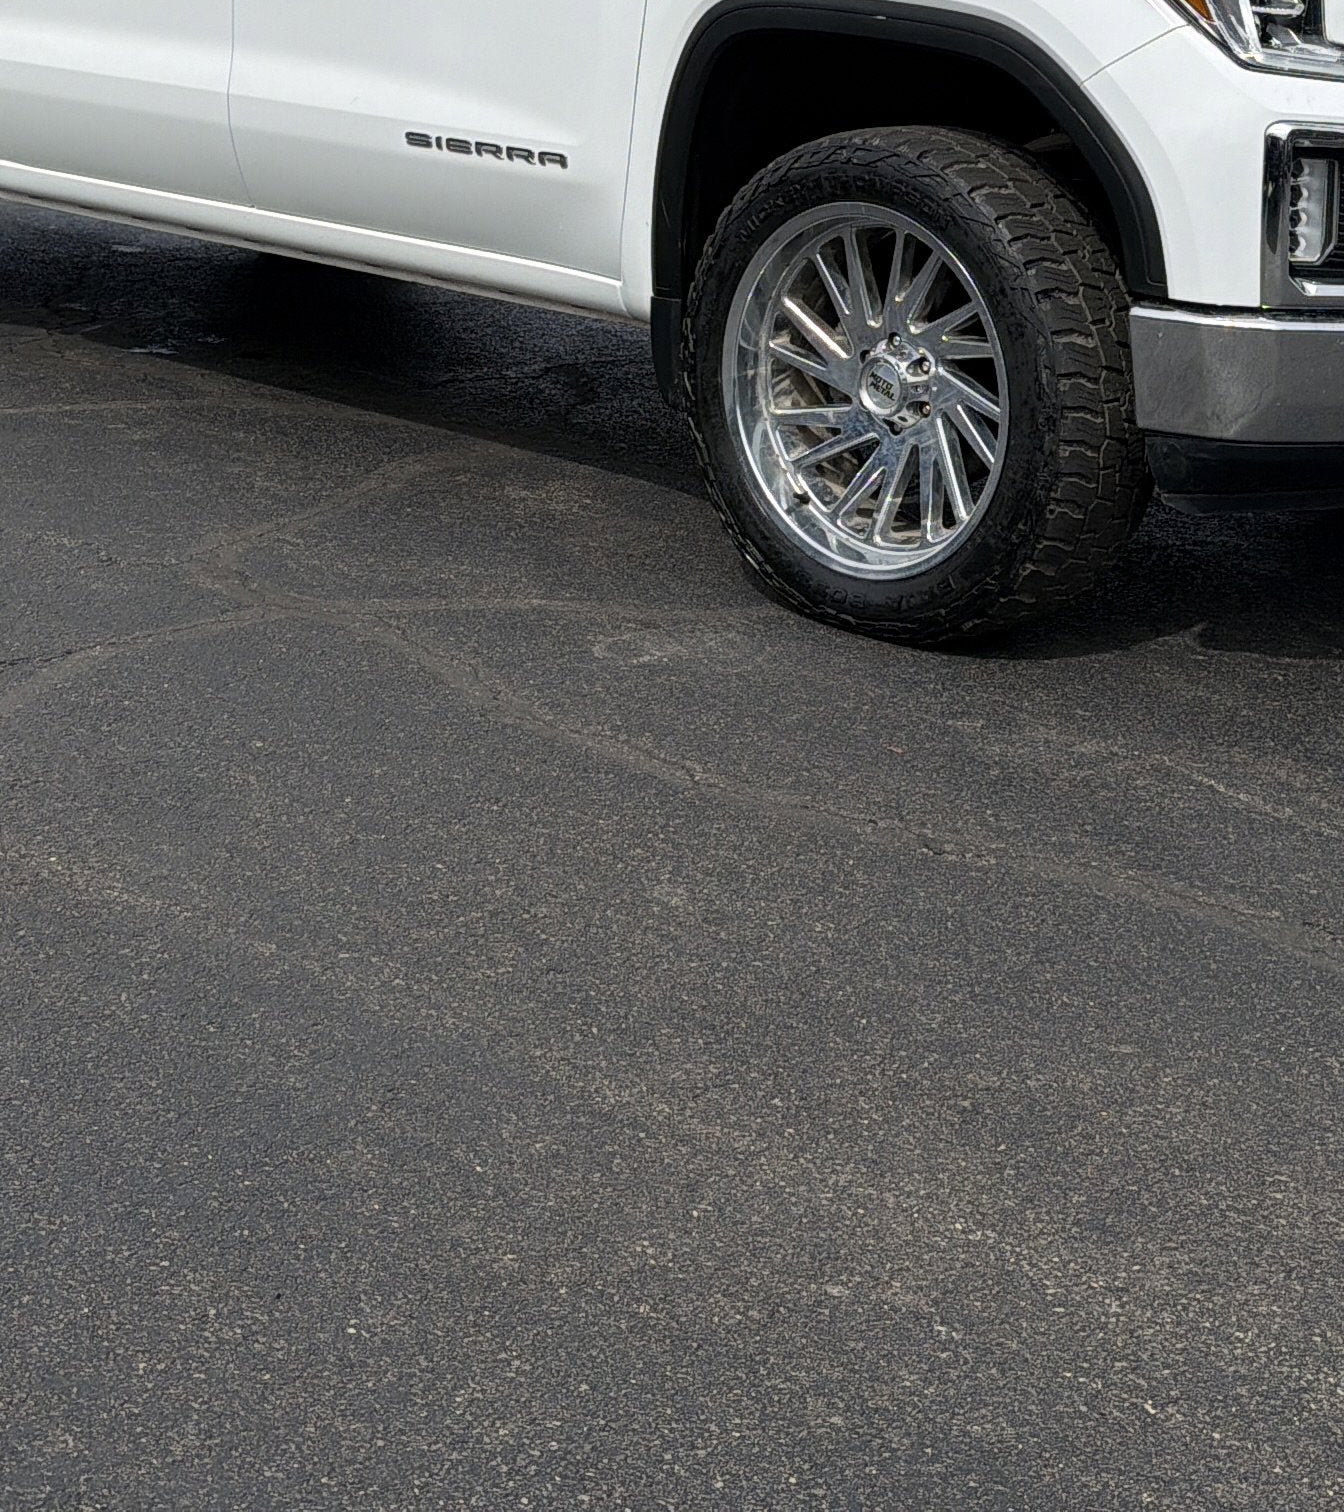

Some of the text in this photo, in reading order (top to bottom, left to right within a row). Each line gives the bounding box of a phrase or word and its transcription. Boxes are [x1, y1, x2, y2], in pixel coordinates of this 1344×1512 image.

[405, 131, 568, 169] SIERRA
[869, 371, 894, 390] MOTO
[869, 380, 895, 401] METAL
